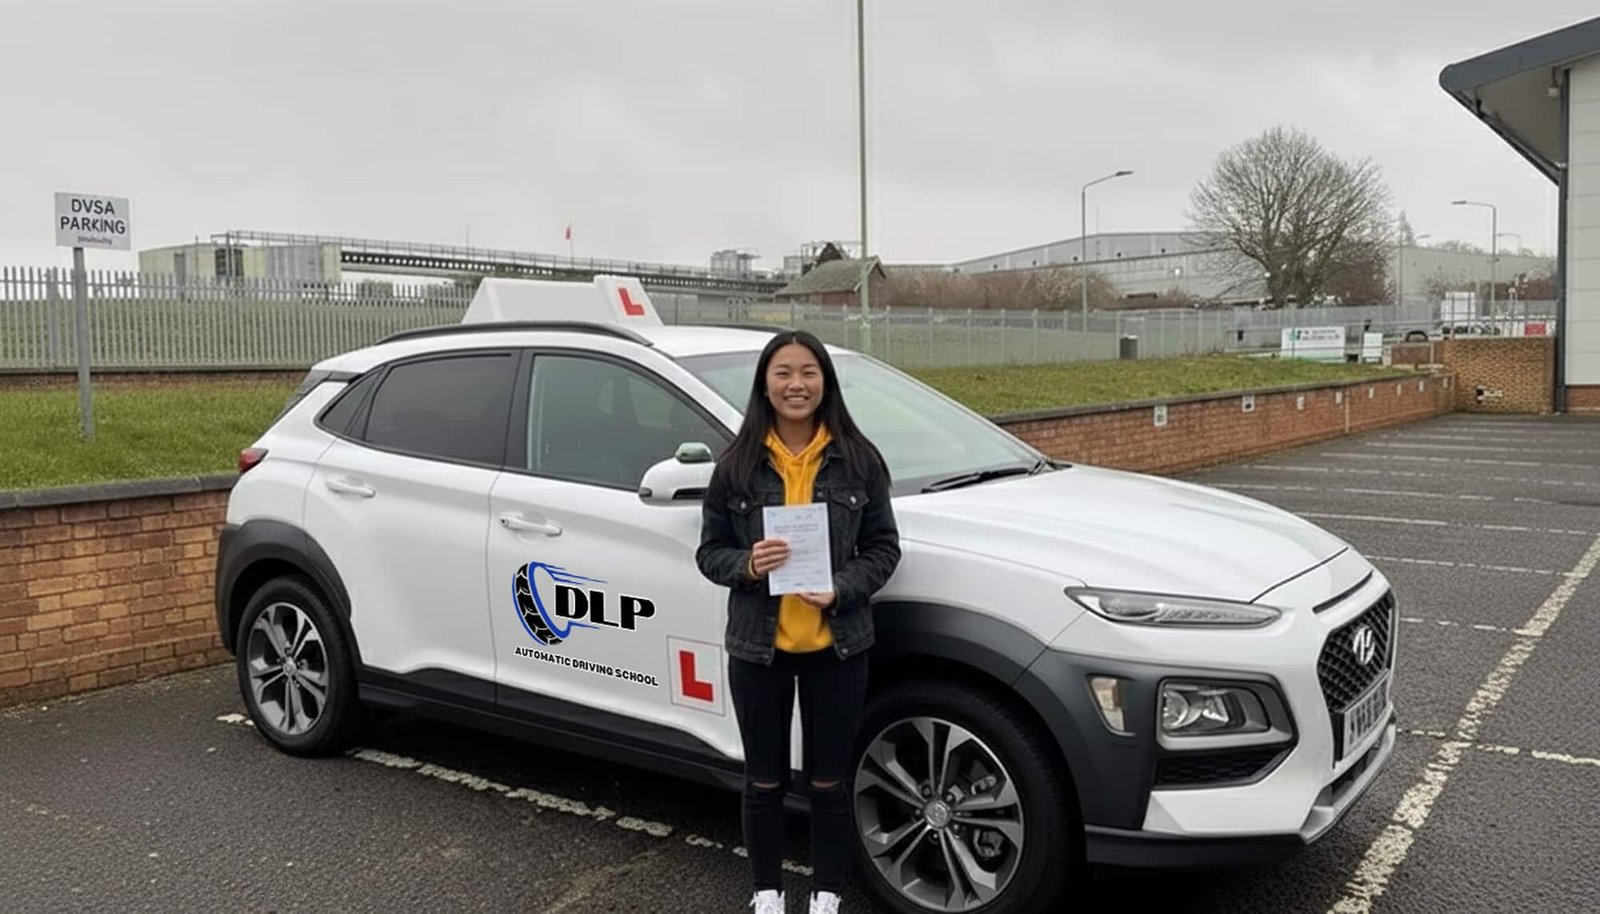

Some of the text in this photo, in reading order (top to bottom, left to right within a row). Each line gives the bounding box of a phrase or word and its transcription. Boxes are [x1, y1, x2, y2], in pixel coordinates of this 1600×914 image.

[71, 198, 115, 215] DVSA
[60, 215, 126, 235] PARKING
[618, 287, 645, 316] L
[555, 584, 656, 630] DLP
[514, 646, 659, 687] AUTOMATIC DRIVING SCHOOL
[679, 650, 714, 702] L
